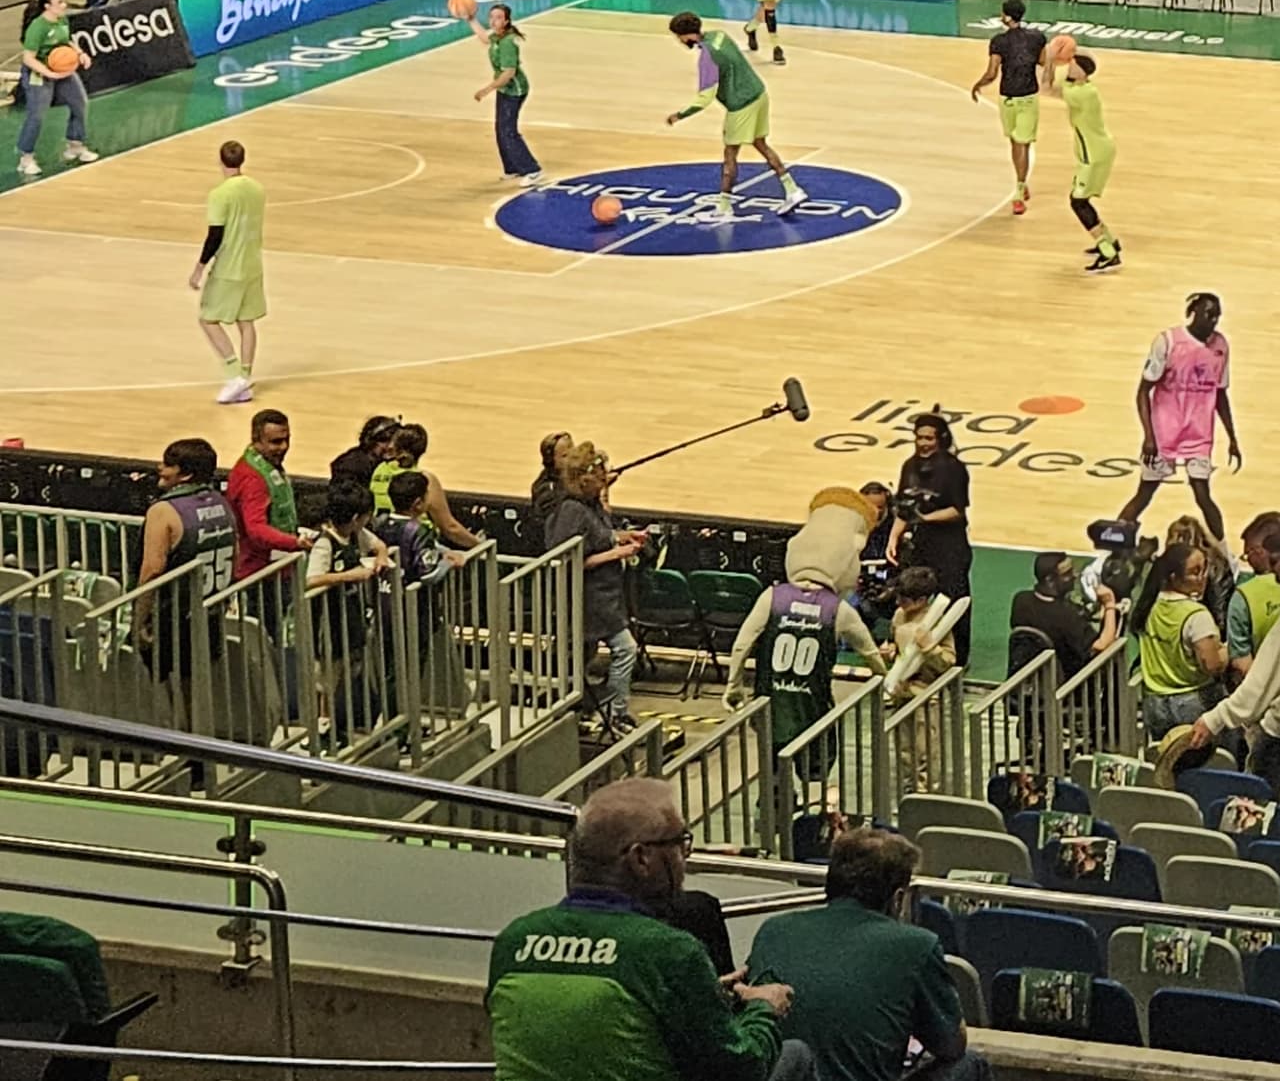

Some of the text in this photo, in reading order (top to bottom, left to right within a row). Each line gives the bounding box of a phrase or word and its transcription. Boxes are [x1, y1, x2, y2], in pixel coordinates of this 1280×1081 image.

[72, 7, 174, 57] ndesa
[214, 15, 458, 87] endesa
[772, 633, 820, 676] 00
